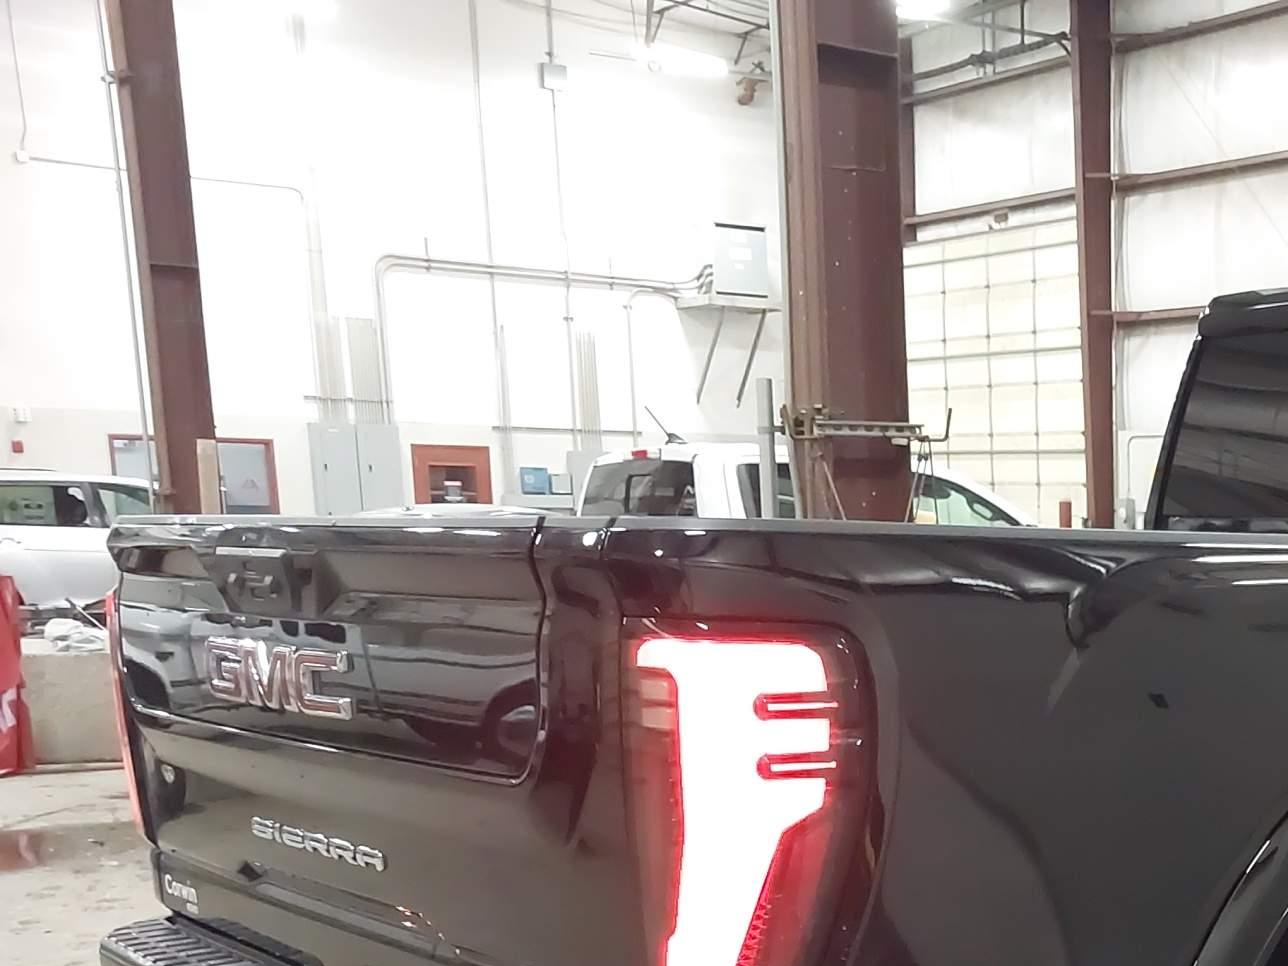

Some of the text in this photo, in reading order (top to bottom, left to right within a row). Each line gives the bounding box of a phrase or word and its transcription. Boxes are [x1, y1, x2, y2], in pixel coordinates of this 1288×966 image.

[205, 636, 352, 721] GMC
[251, 816, 384, 872] SIERRA
[165, 874, 197, 904] Corwin
